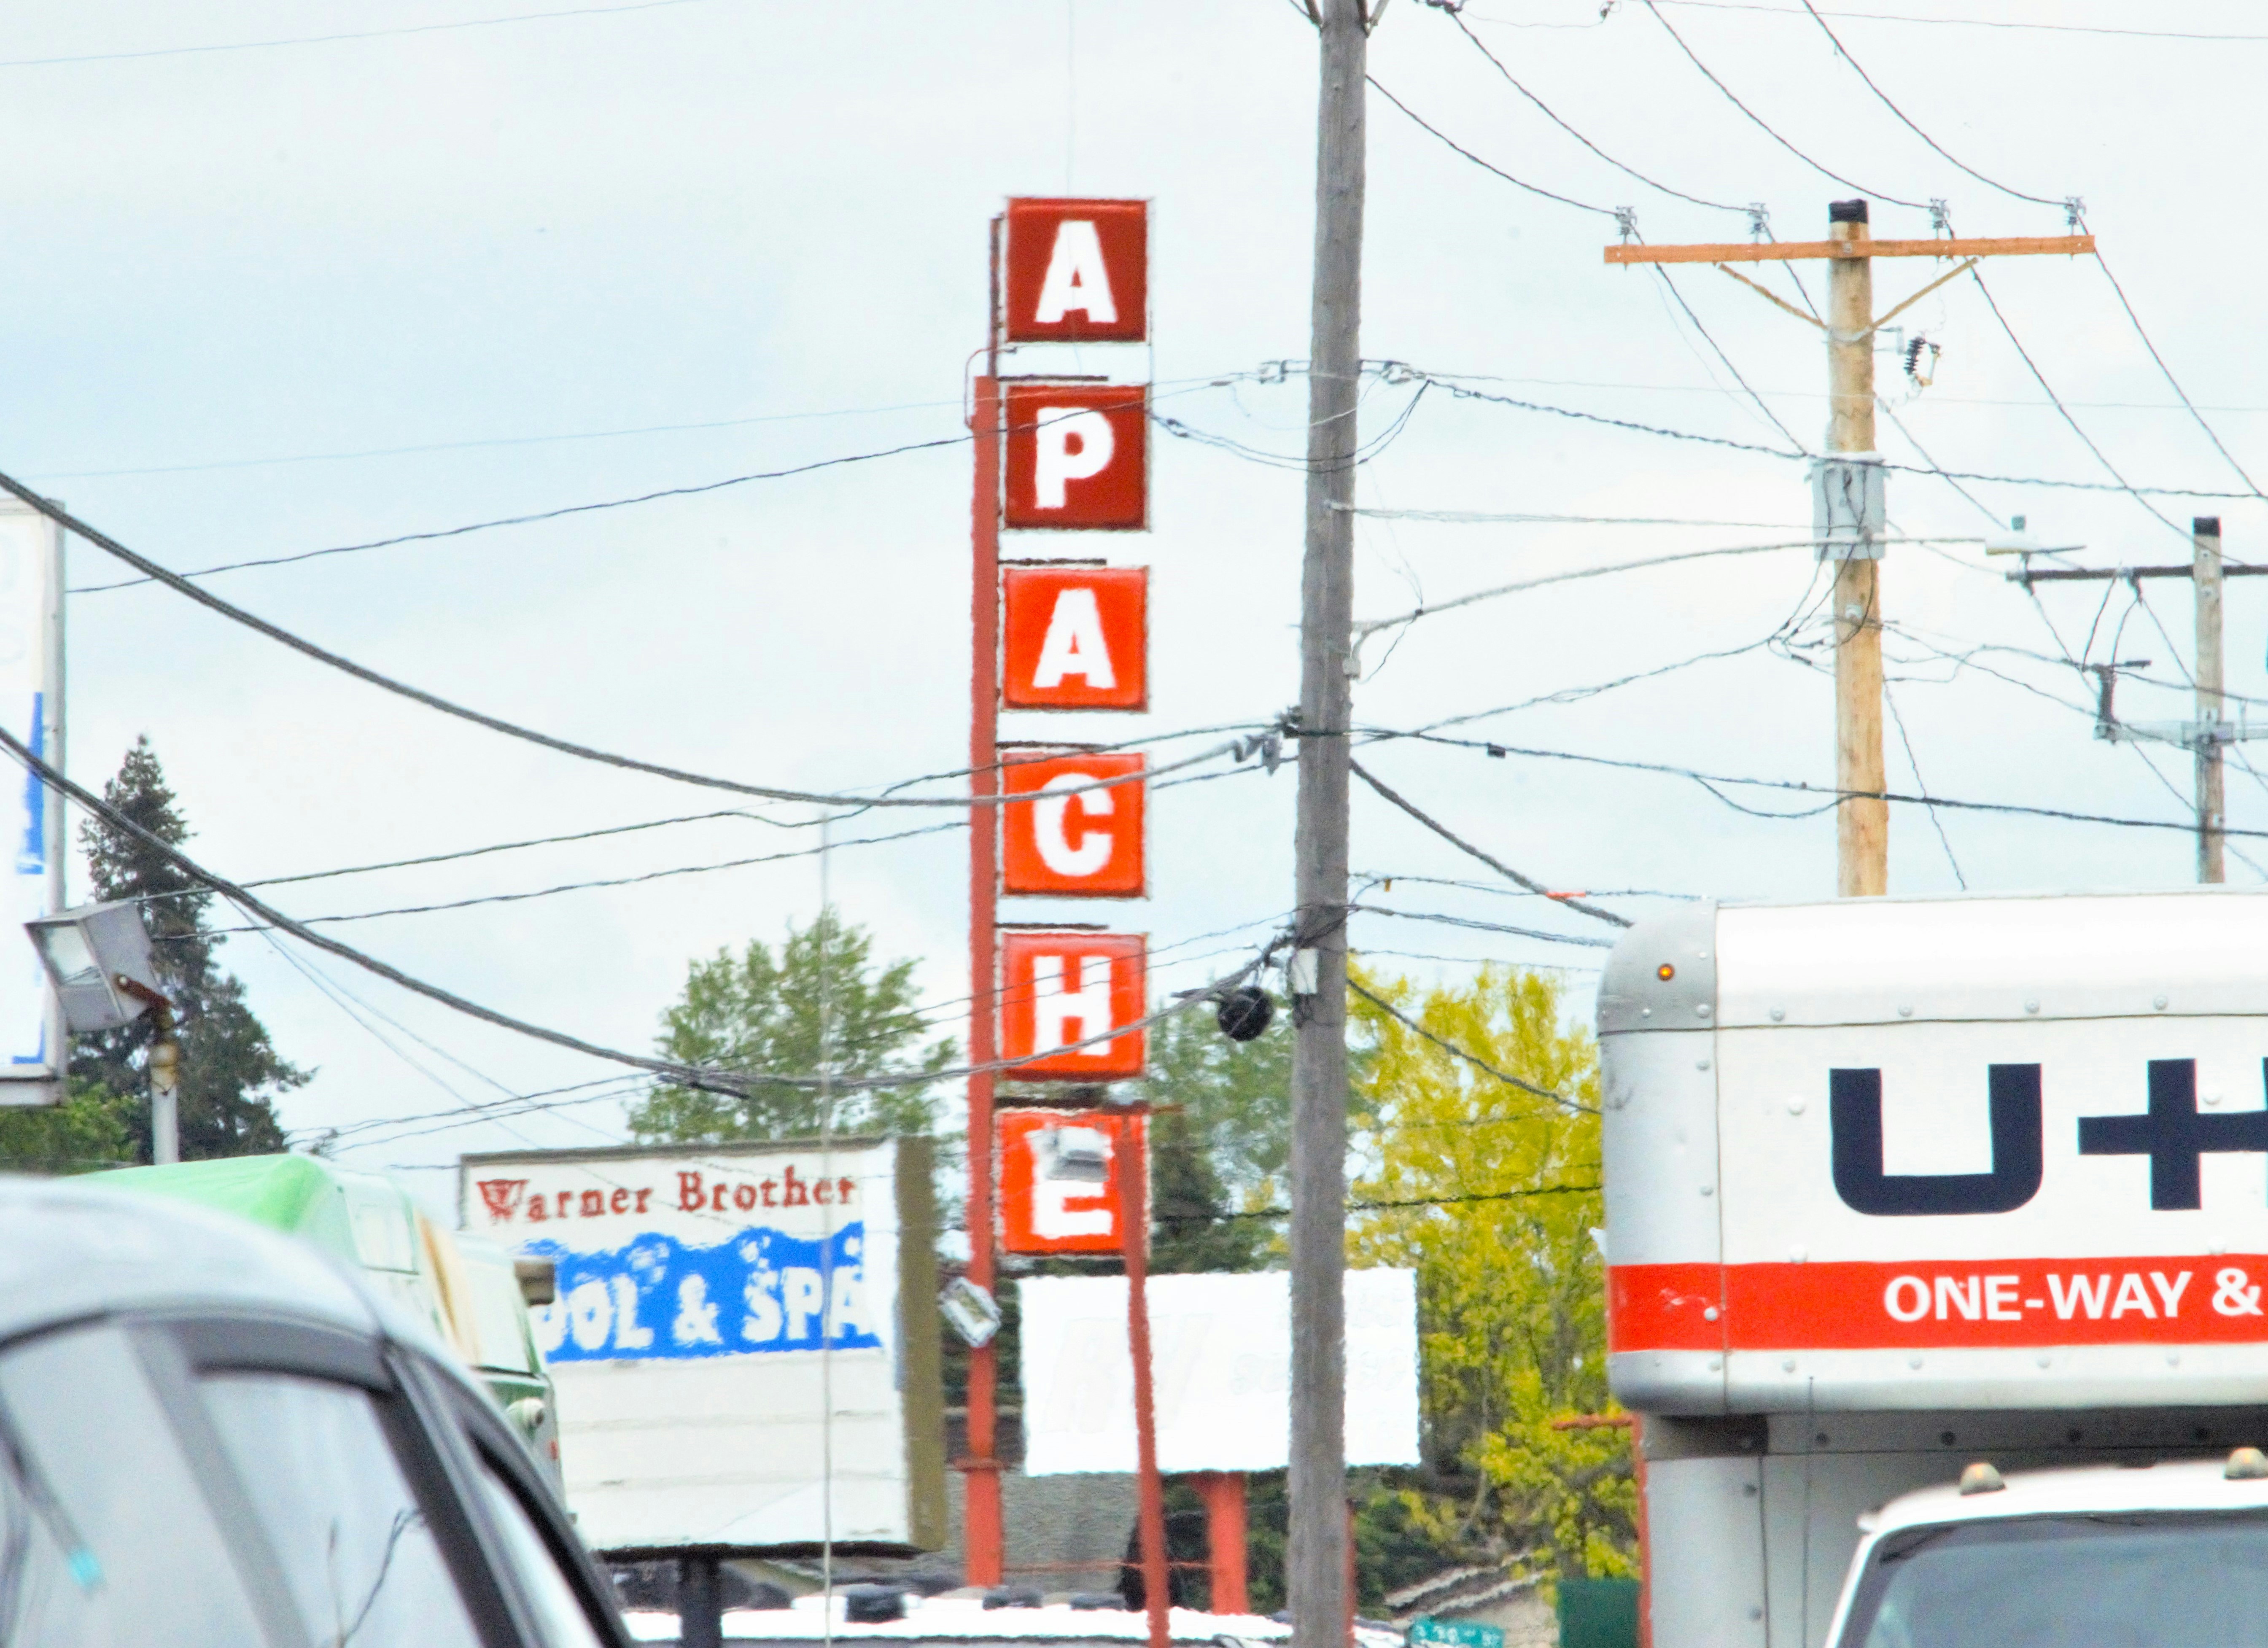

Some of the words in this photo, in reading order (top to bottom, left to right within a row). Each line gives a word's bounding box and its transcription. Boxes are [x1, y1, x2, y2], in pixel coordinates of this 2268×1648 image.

[1030, 219, 1118, 1239] APACHE
[477, 1179, 653, 1225] Warner
[528, 1273, 654, 1351] OOL
[673, 1274, 723, 1346] &
[741, 1265, 874, 1343] SPA
[1883, 1270, 2193, 1323] ONE-WAY
[2211, 1267, 2265, 1317] &
